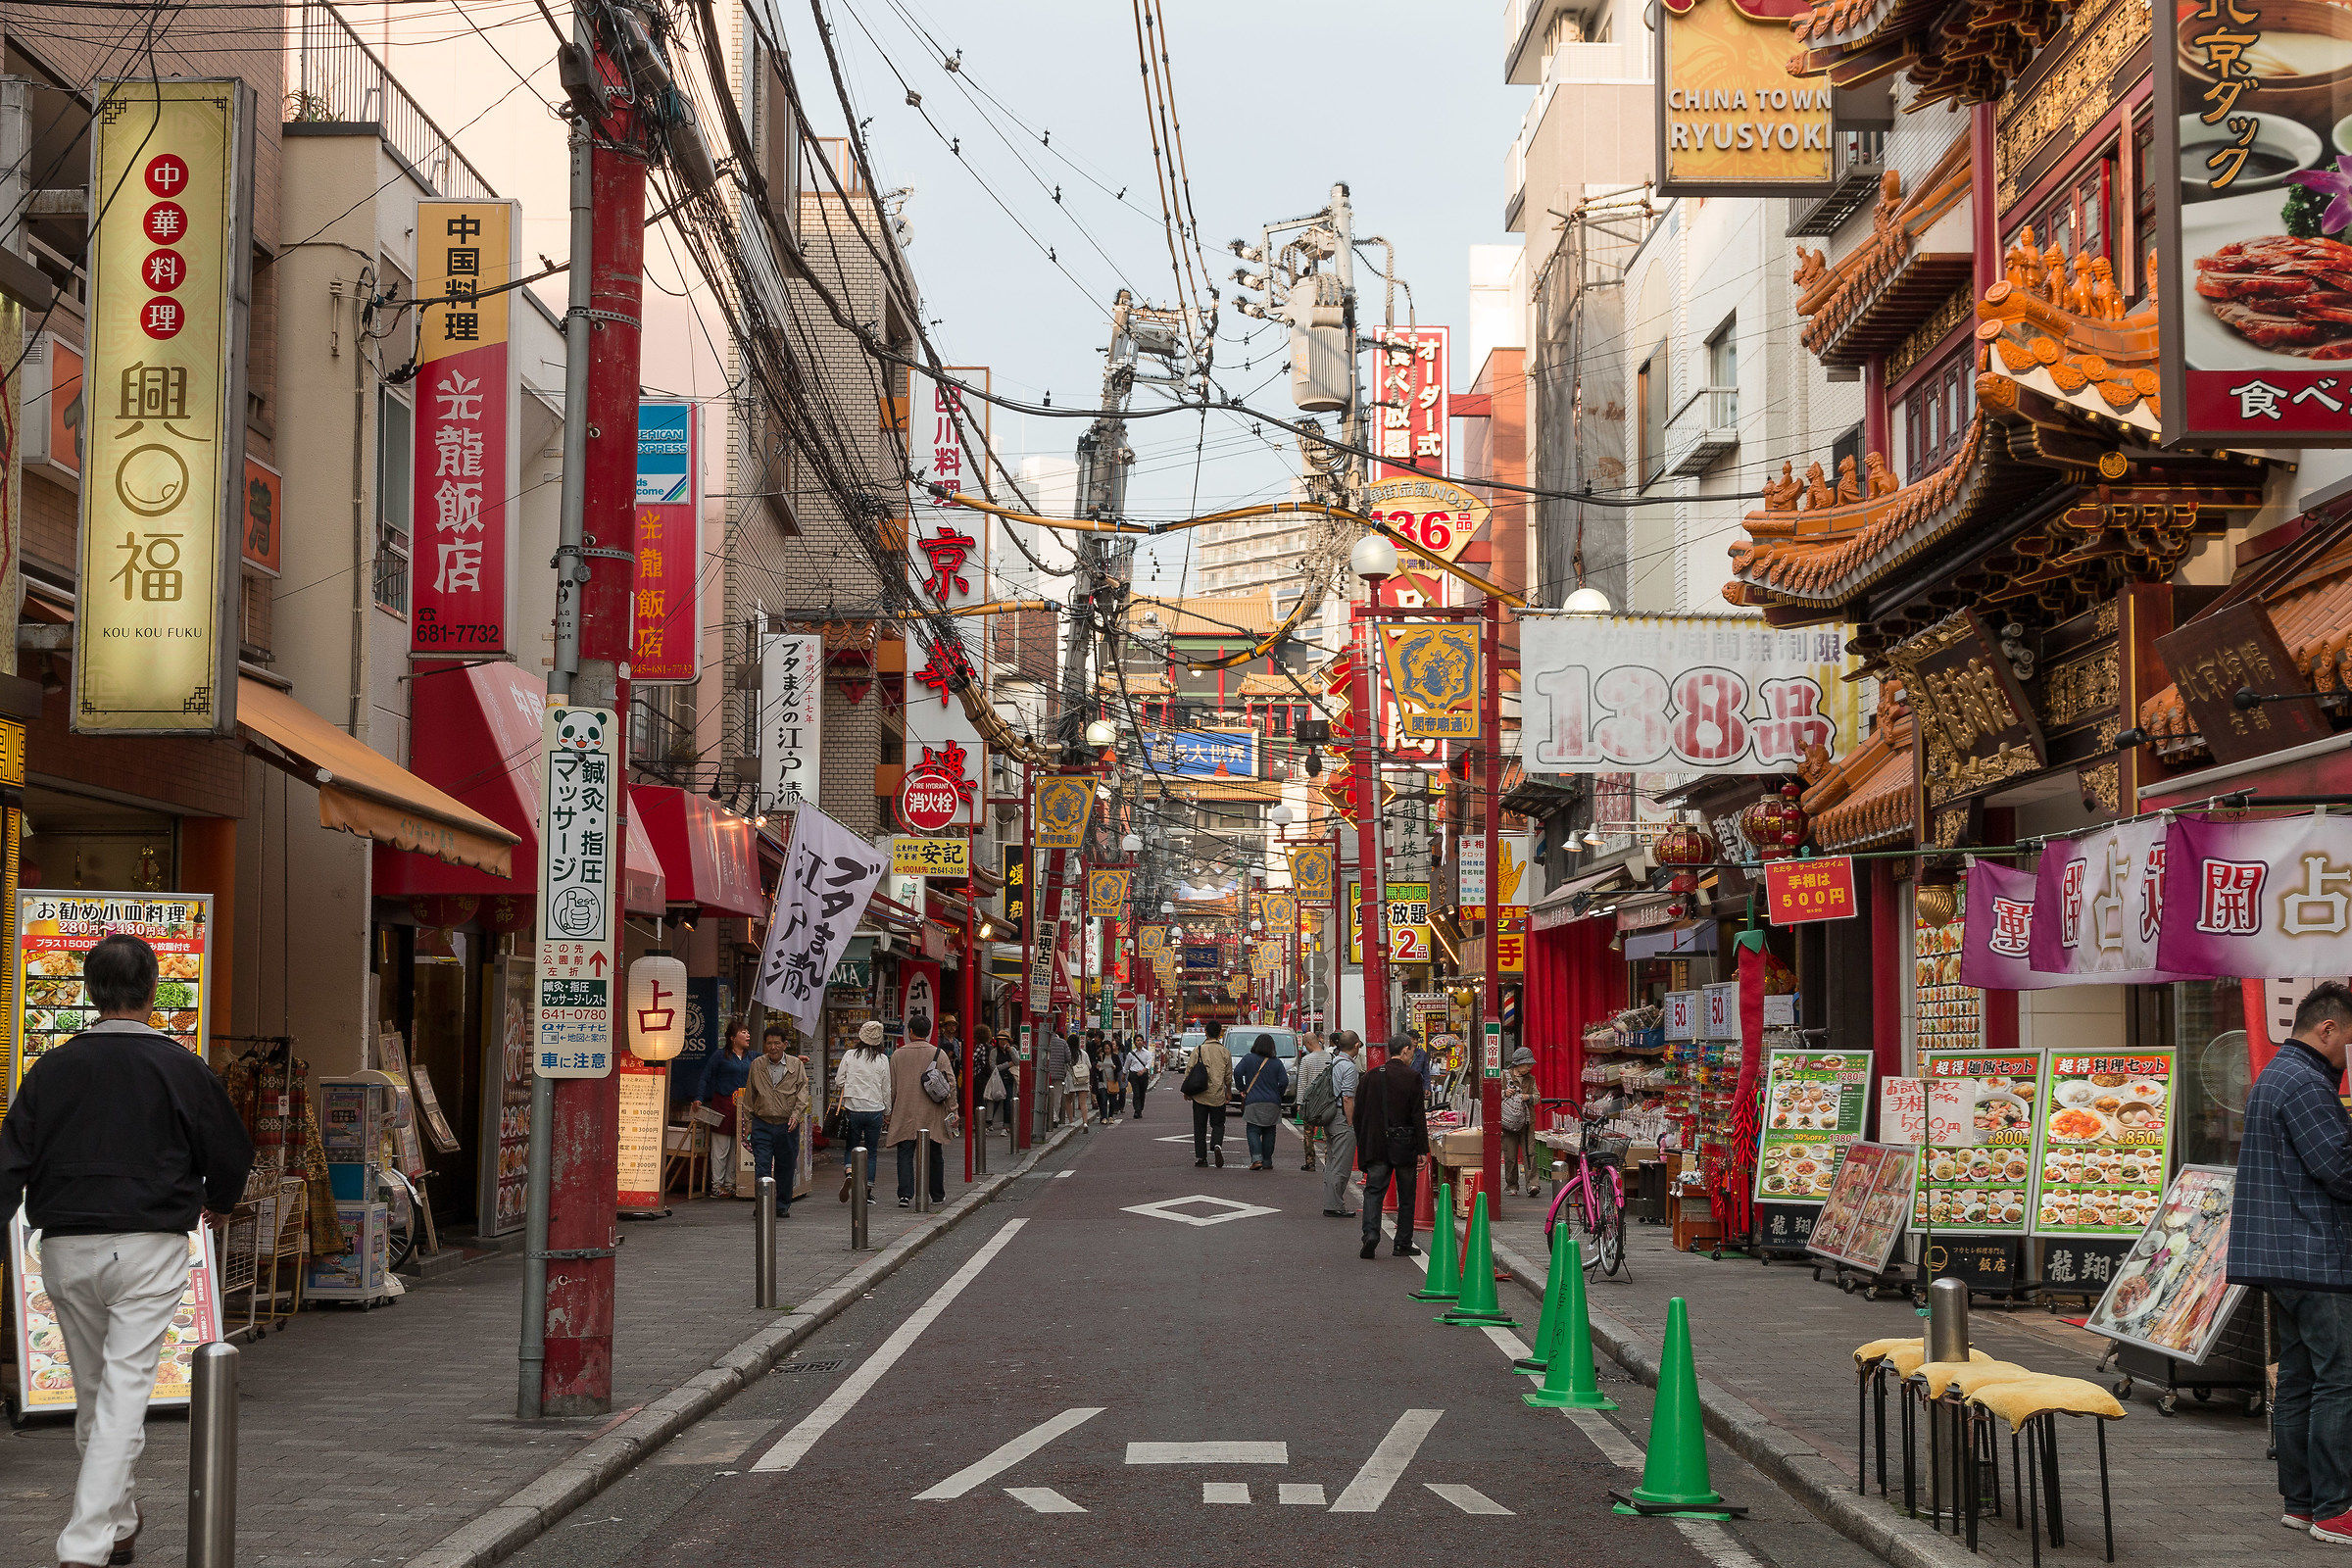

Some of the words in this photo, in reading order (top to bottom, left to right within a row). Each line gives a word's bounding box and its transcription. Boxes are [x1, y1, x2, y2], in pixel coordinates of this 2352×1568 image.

[1669, 88, 1748, 111] CHINA
[1756, 88, 1832, 111] TOWN
[2194, 0, 2260, 188] 北京ダック
[146, 162, 181, 333] 中華料理
[446, 214, 480, 342] 中国料理
[1417, 337, 1442, 457] オーダー式
[2230, 379, 2352, 419] 食べ
[432, 369, 485, 594] 光龍飯店
[637, 510, 665, 658] 光龍飯店
[103, 627, 131, 638] KOU
[135, 627, 165, 638] KOU
[168, 627, 203, 638] FUKU
[416, 624, 499, 643] 681-7732
[1411, 716, 1473, 732] 関帝廟通り
[908, 792, 954, 812] 消火栓
[552, 759, 578, 882] マッサージ
[580, 760, 605, 884] 鍼灸・指圧
[920, 841, 964, 864] 安記
[1461, 840, 1485, 849] 手相
[1798, 860, 1844, 870] サービスタイム
[1788, 873, 1832, 889] 手相は
[1783, 888, 1845, 907] 500円
[35, 902, 187, 924] お勧め小皿料理
[543, 944, 584, 954] この先
[543, 956, 584, 965] 公園前
[548, 967, 579, 977] 左折
[543, 981, 590, 993] 鍼灸・指圧
[543, 994, 606, 1005] マッサージ・レスト
[637, 979, 675, 1034] 占
[542, 1008, 607, 1020] 641-0780
[541, 1052, 606, 1069] 車に注意
[1487, 1035, 1498, 1068] 関帝廟
[2059, 1057, 2165, 1074] 超得料理セット
[1979, 1257, 2007, 1272] 飯店
[2048, 1250, 2128, 1283] 龍翔
